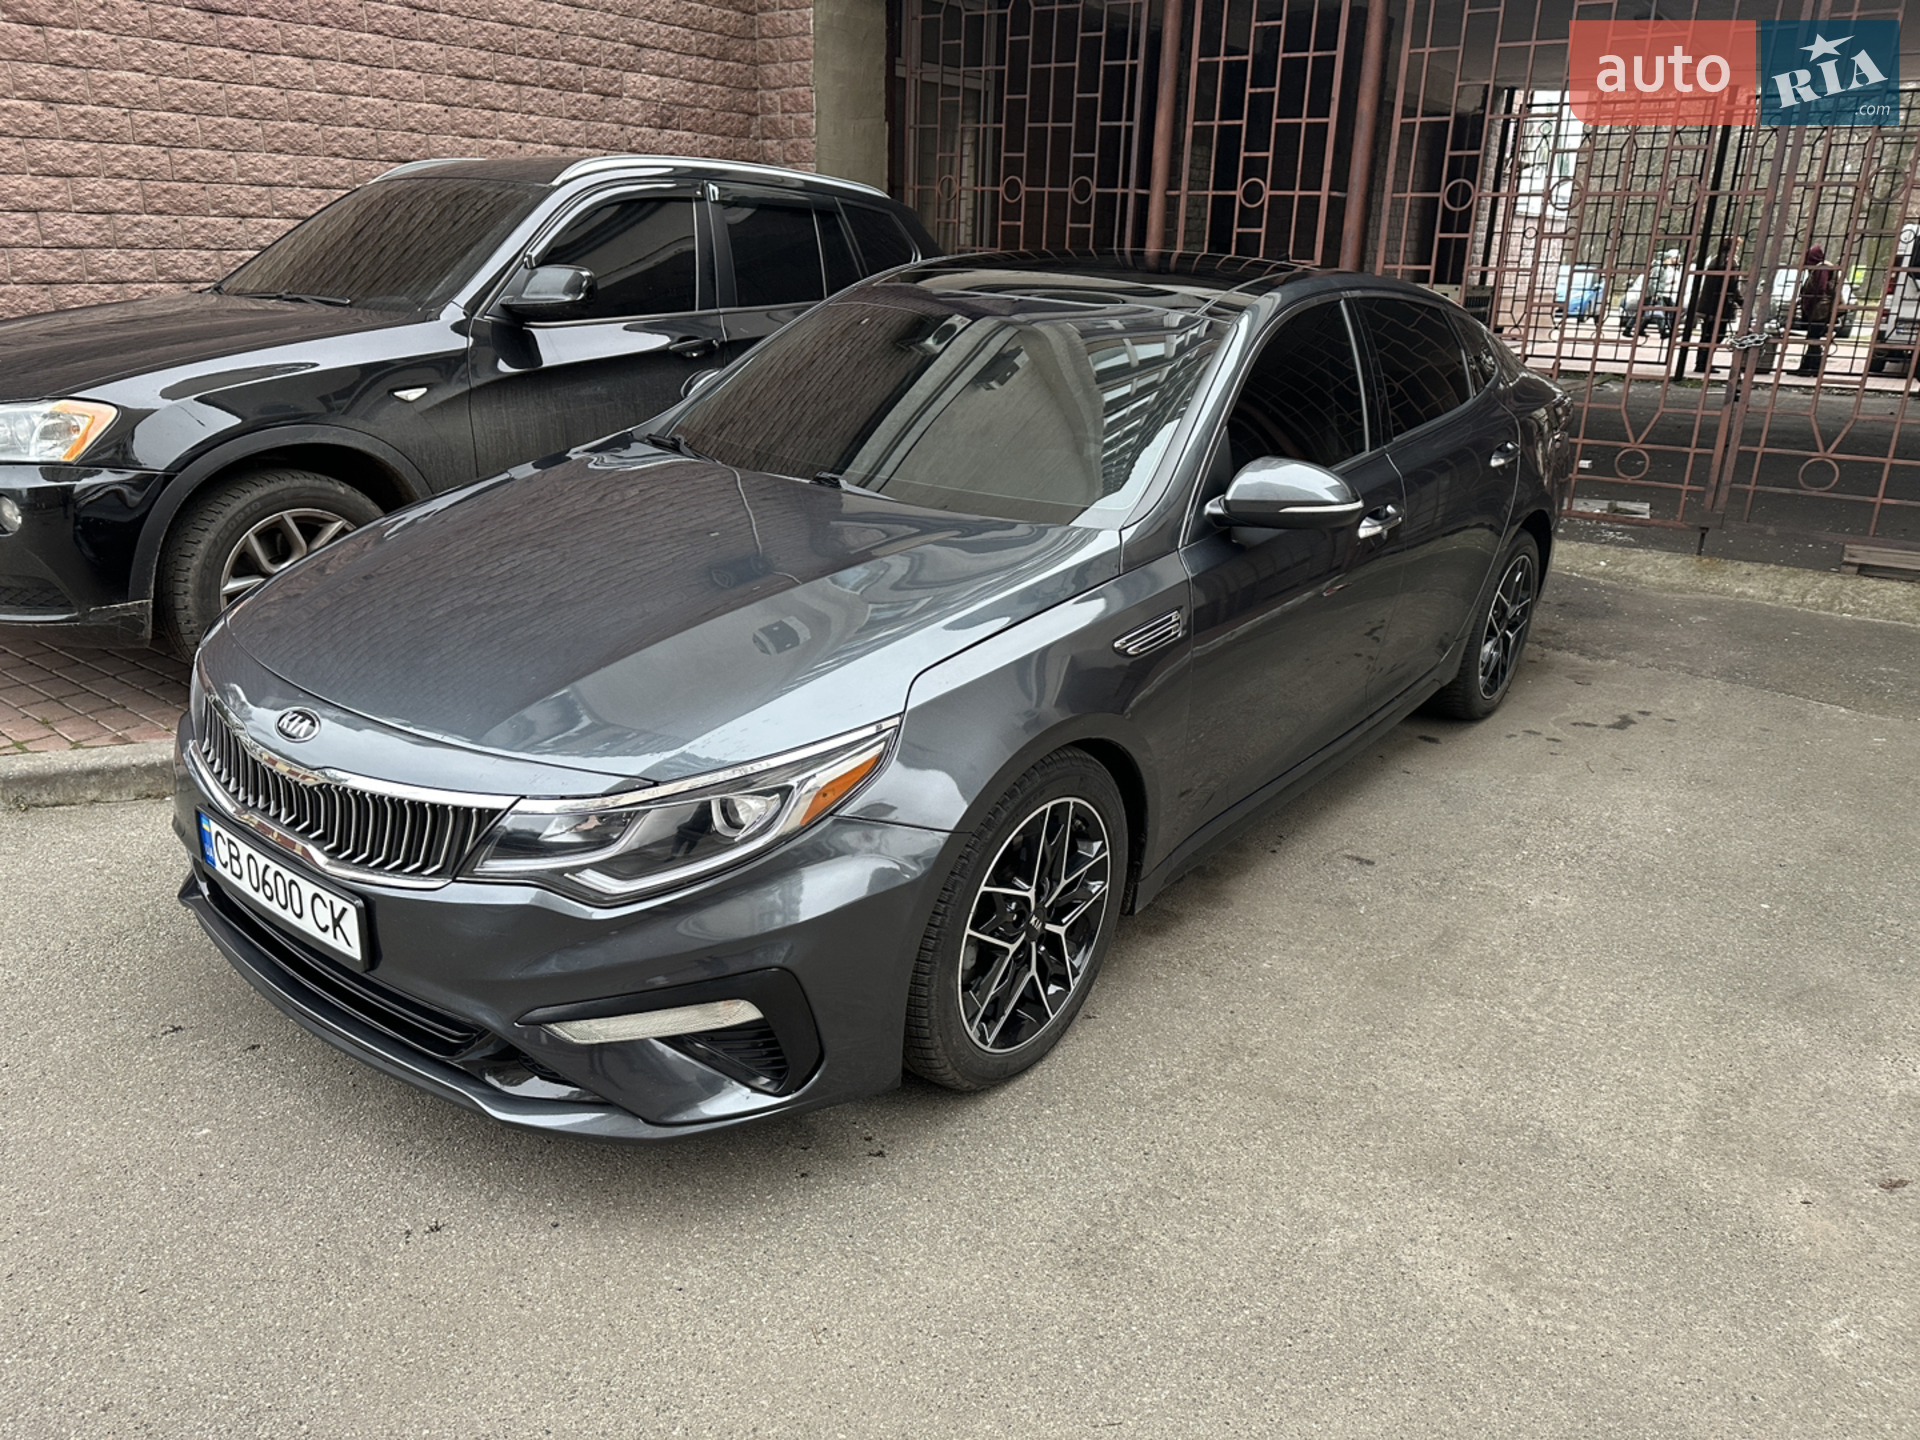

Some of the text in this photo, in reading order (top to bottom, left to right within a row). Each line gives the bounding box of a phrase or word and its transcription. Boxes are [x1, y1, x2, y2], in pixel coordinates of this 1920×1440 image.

[277, 711, 311, 738] KIA
[213, 831, 353, 949] CB 0600 CK
